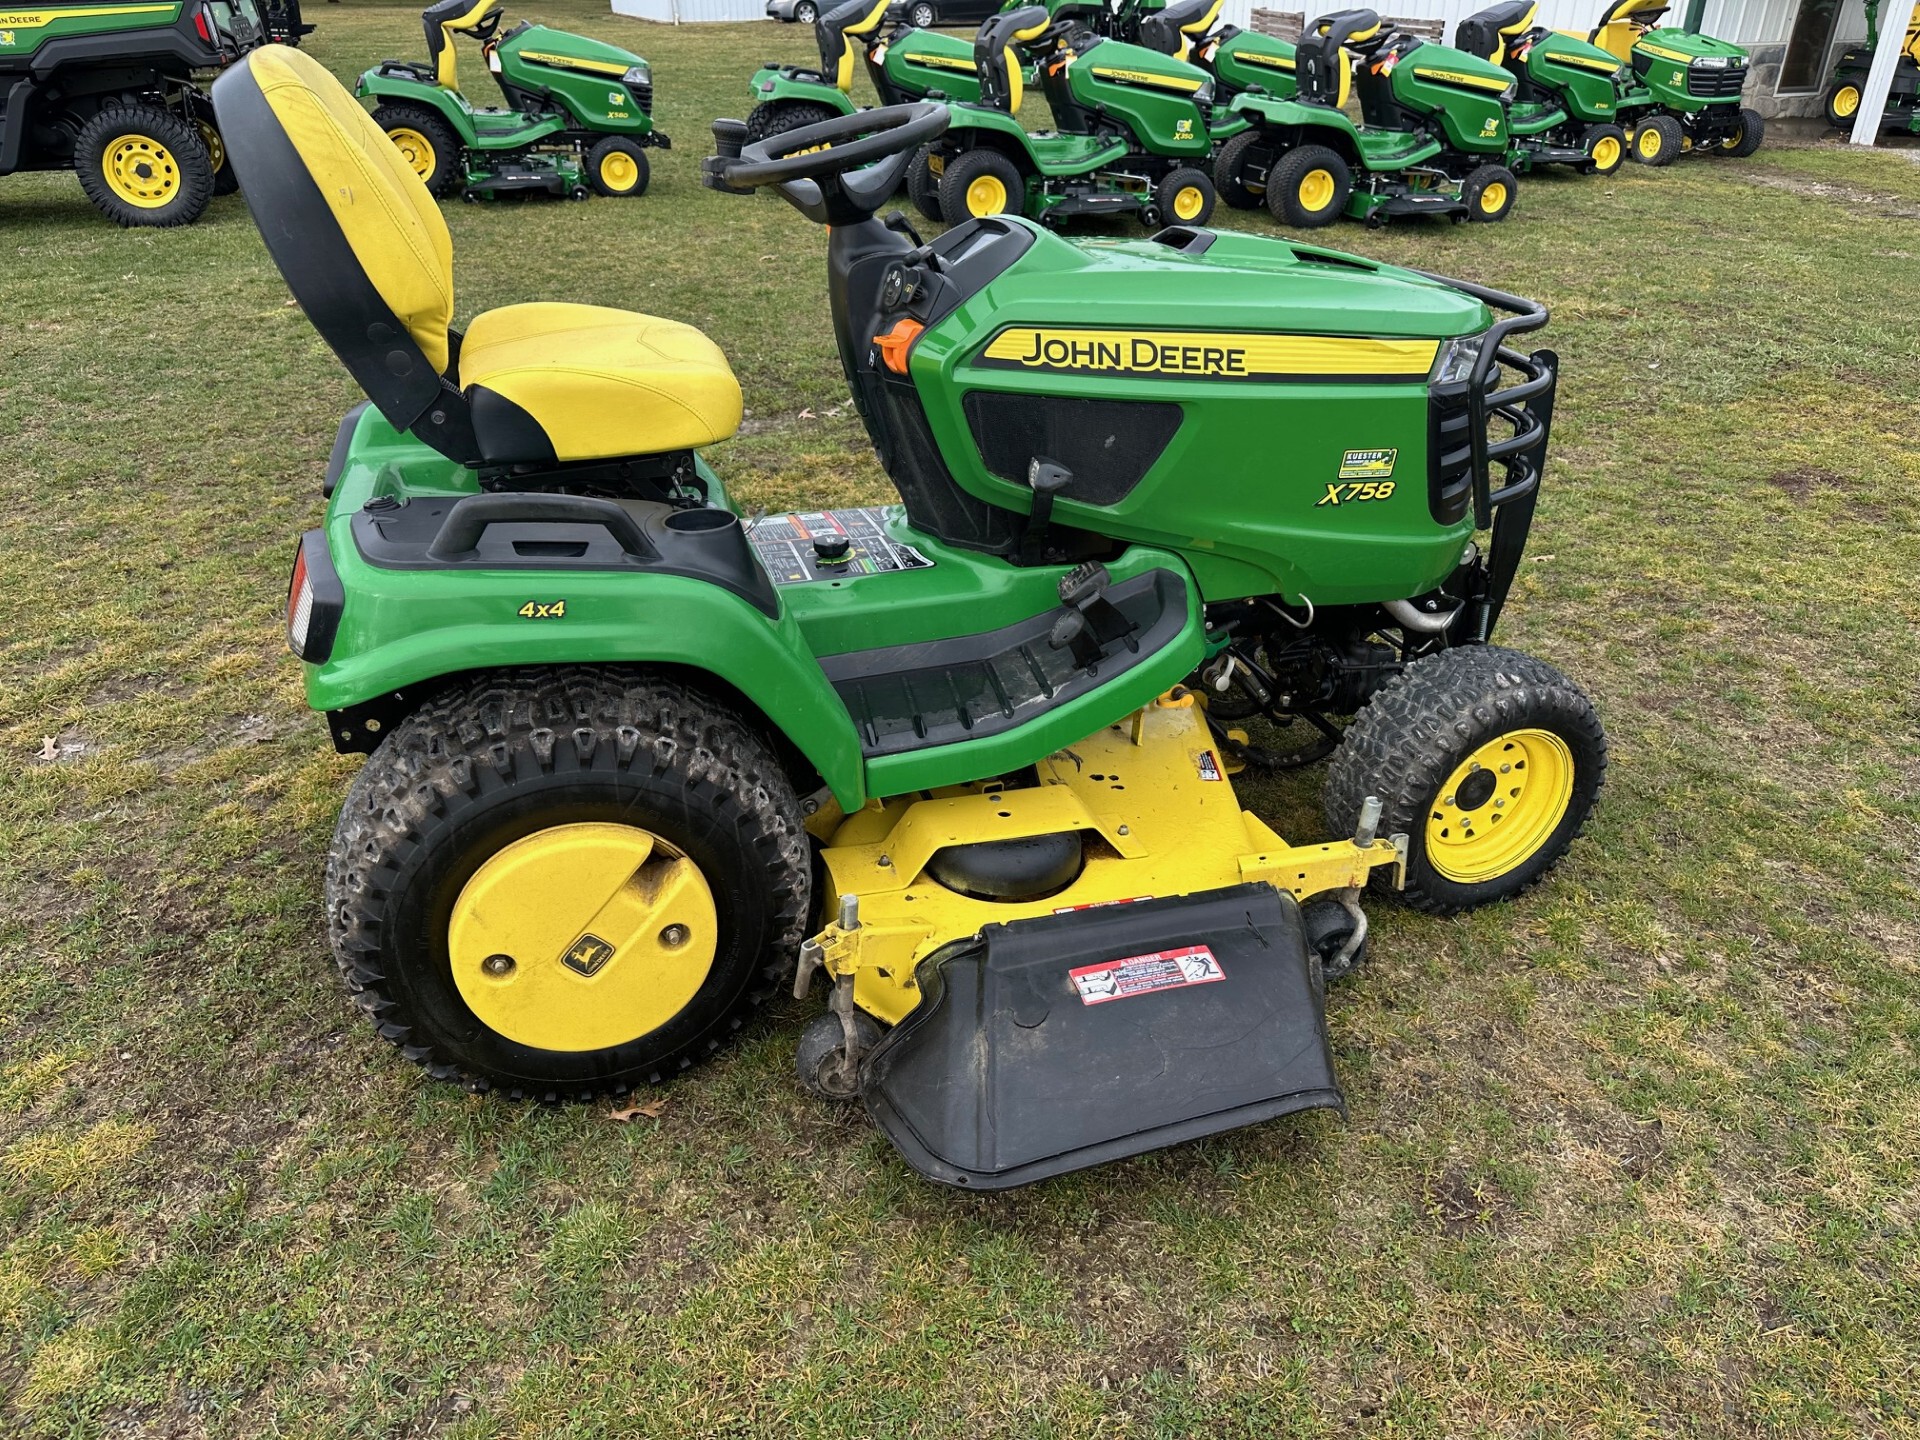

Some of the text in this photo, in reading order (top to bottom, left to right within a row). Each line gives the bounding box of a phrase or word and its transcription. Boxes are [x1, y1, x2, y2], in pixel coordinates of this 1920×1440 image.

[9, 16, 42, 24] DEERE
[1110, 70, 1149, 82] JOHN DEERE
[607, 111, 629, 119] X580
[1173, 132, 1194, 141] X350
[1022, 333, 1246, 372] JOHN DEERE
[1346, 452, 1383, 460] KUESTER
[1316, 482, 1396, 505] X758
[518, 600, 566, 618] 4x4
[1128, 954, 1162, 966] DANGER
